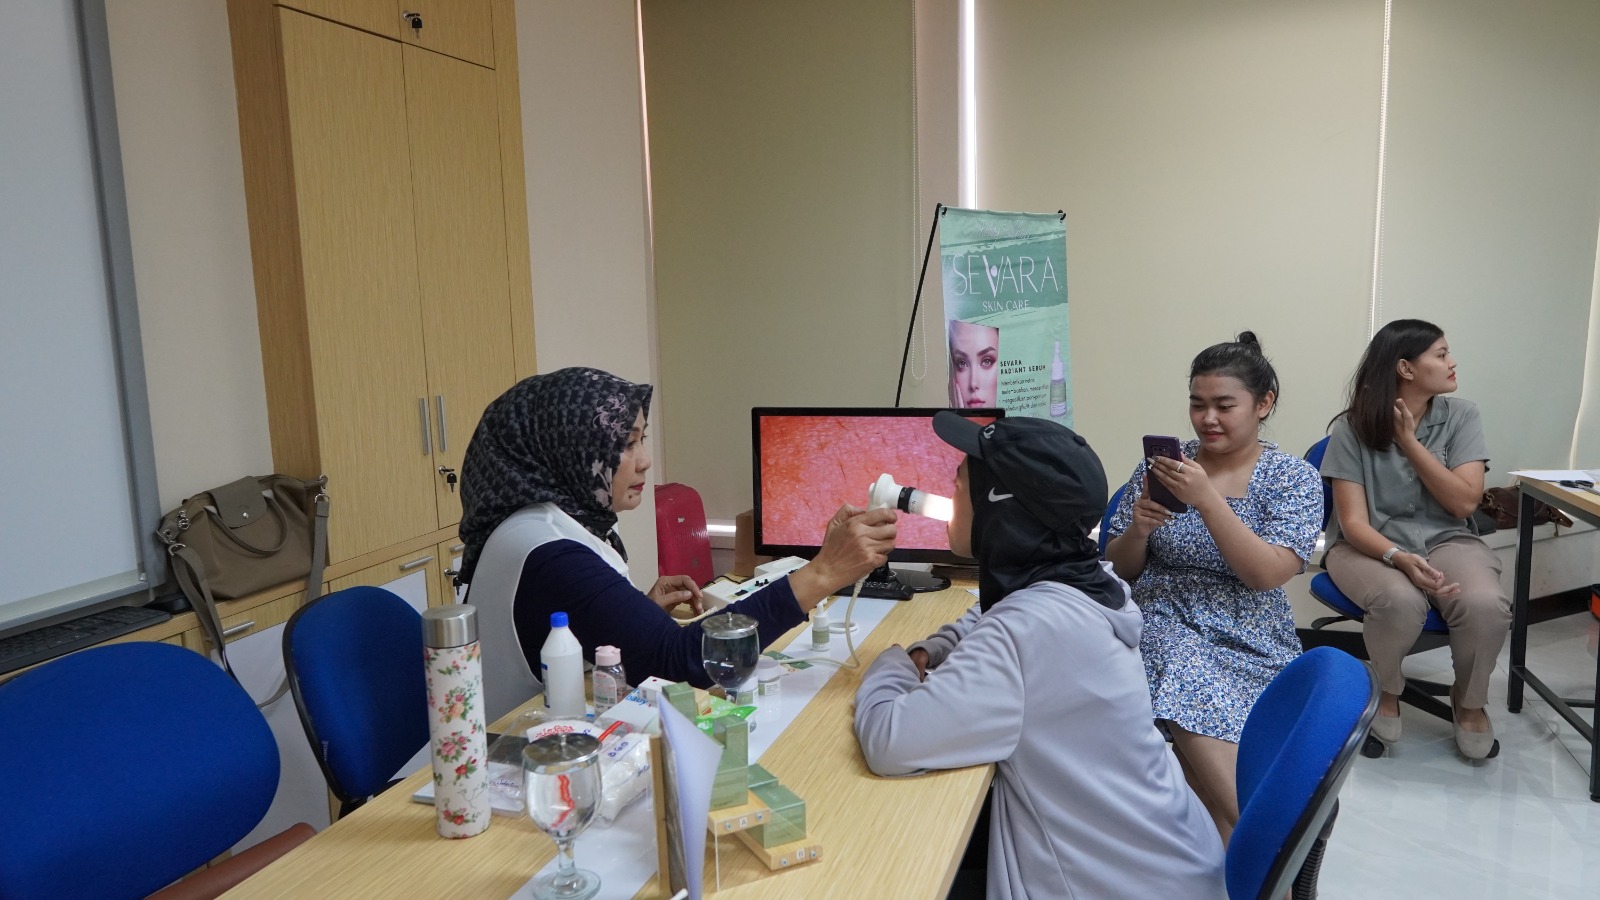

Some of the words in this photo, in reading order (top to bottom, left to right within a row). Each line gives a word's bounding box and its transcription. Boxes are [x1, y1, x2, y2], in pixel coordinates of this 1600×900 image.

[952, 253, 1059, 298] SEVARA
[982, 300, 1004, 312] SKIN
[1005, 299, 1030, 311] CARE
